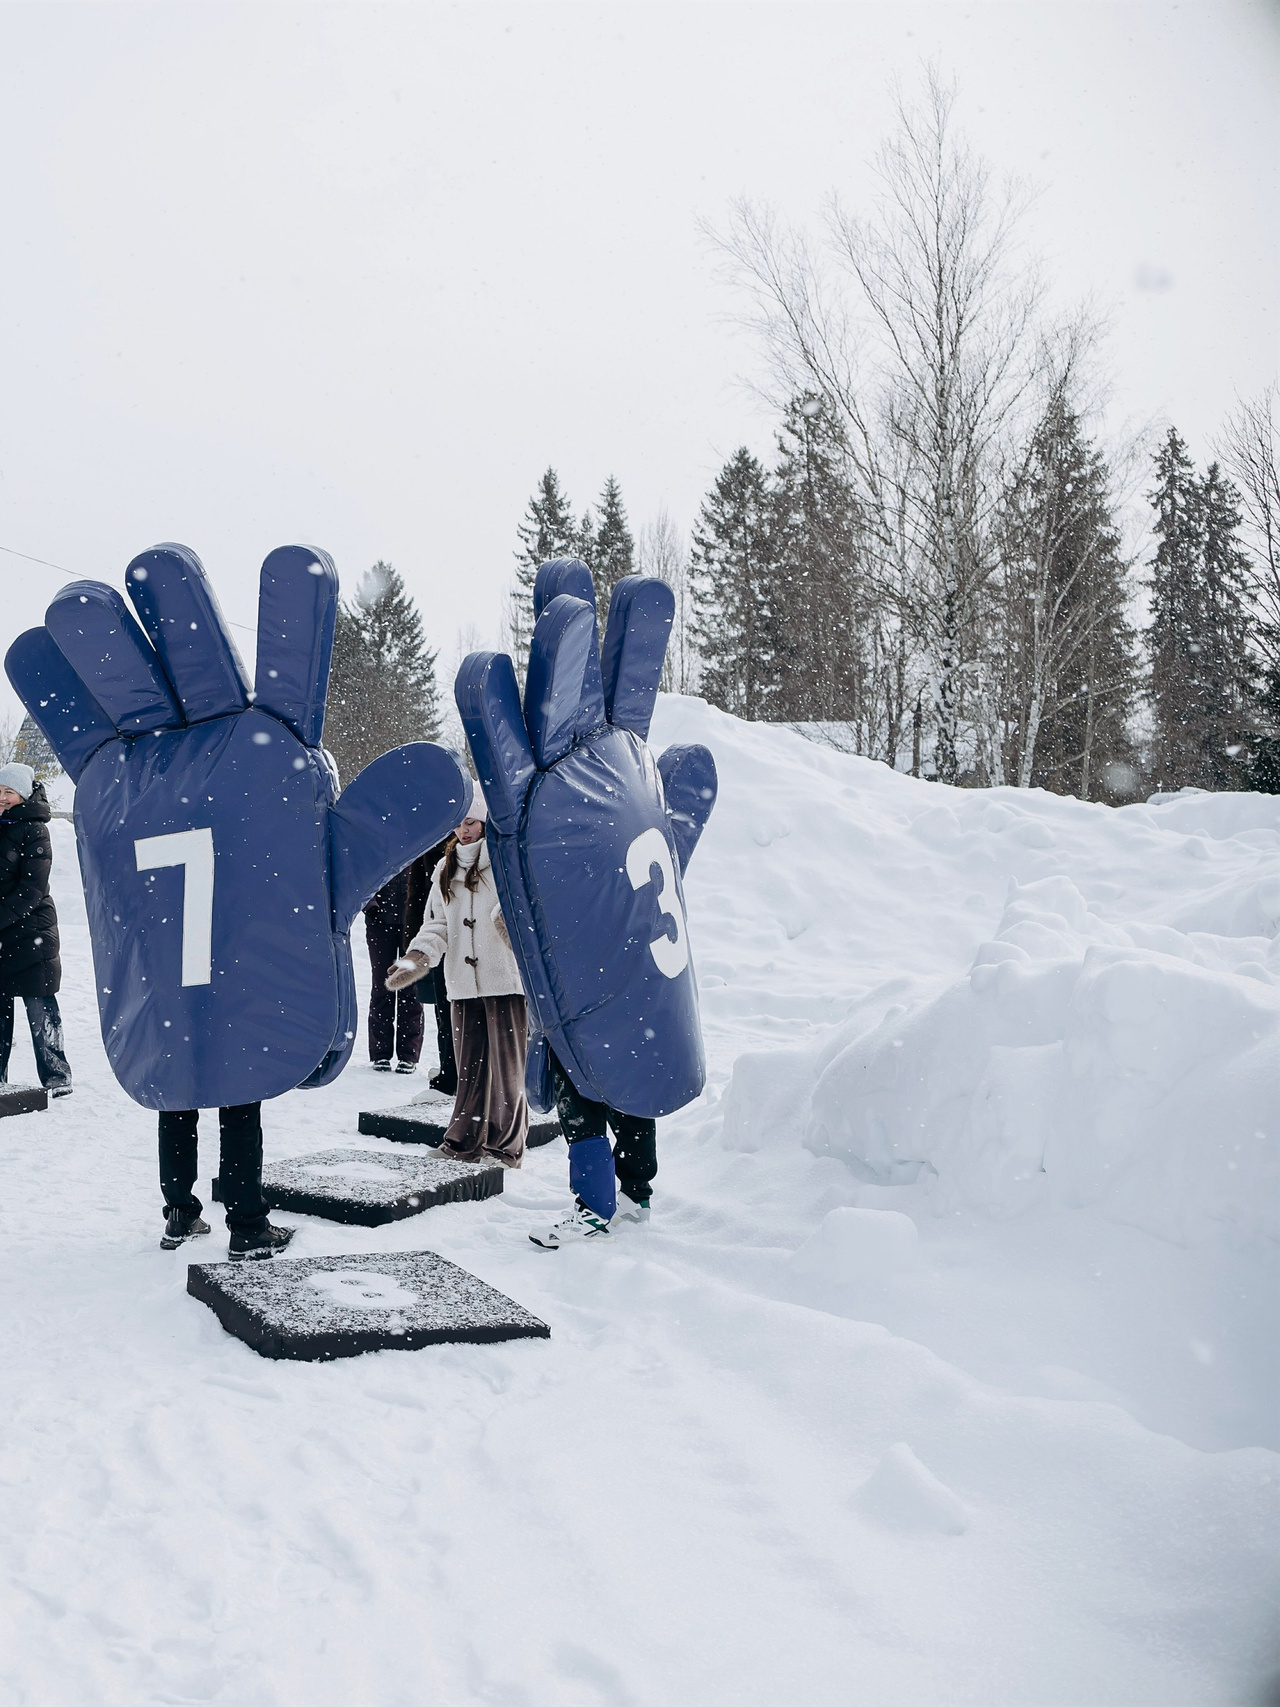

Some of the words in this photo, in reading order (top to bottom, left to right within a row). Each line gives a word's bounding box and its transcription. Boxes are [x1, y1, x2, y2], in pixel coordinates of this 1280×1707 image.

[133, 827, 214, 988] 7
[625, 827, 689, 979] 3
[307, 1271, 418, 1308] 8
